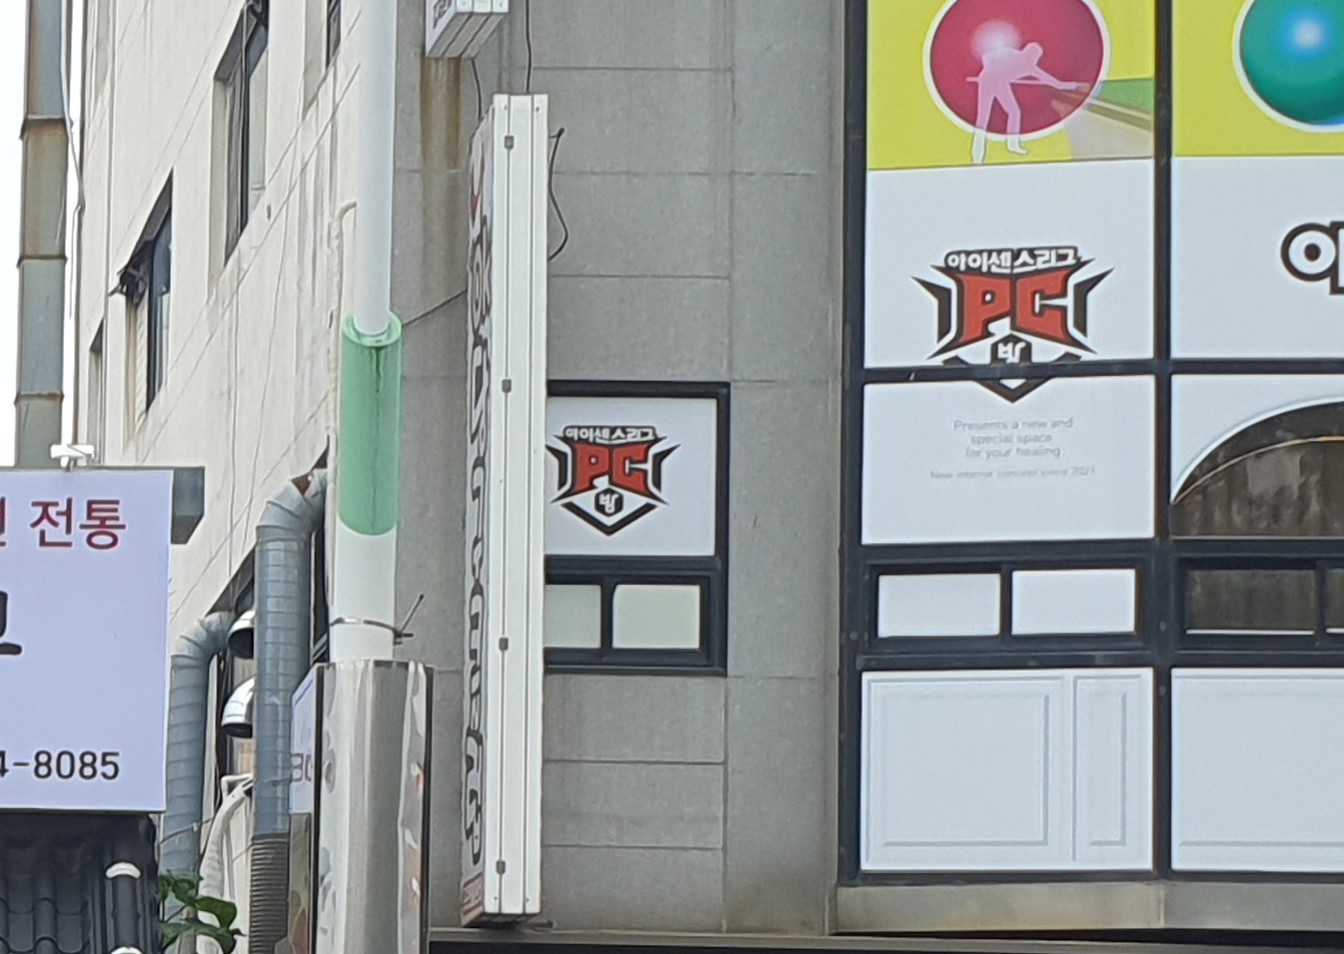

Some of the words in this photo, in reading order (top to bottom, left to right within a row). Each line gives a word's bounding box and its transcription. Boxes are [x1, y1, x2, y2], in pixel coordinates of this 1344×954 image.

[946, 249, 1080, 273] 아이센스리그
[958, 269, 1071, 347] PC
[565, 427, 655, 444] 아이센스리그
[572, 443, 650, 496] PC
[29, 497, 128, 551] 전통
